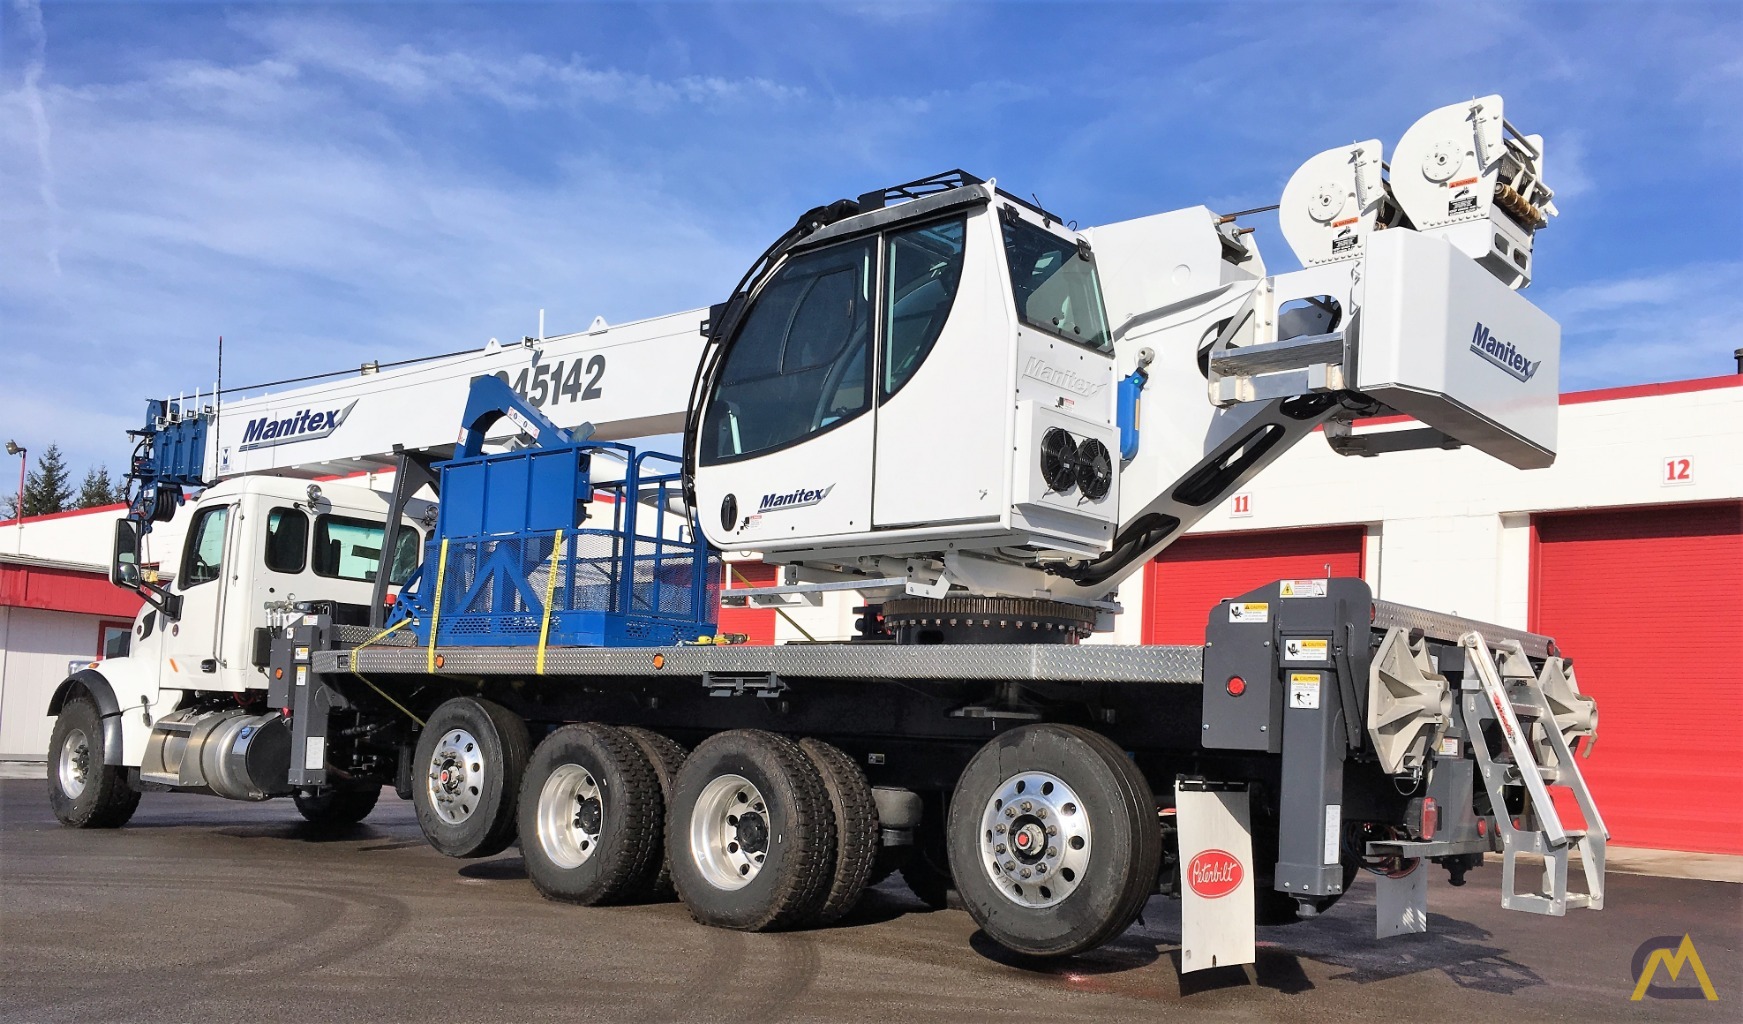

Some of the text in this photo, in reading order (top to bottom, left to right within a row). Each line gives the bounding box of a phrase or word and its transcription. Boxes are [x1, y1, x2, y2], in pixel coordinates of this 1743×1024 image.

[1472, 321, 1531, 376] Manitex
[470, 354, 606, 408] 45142
[1024, 356, 1096, 394] Manitex
[242, 409, 341, 443] Manitex
[1667, 459, 1690, 480] 12
[760, 489, 824, 509] Manitex
[1234, 495, 1249, 512] 11
[1192, 860, 1237, 886] Peterbilt
